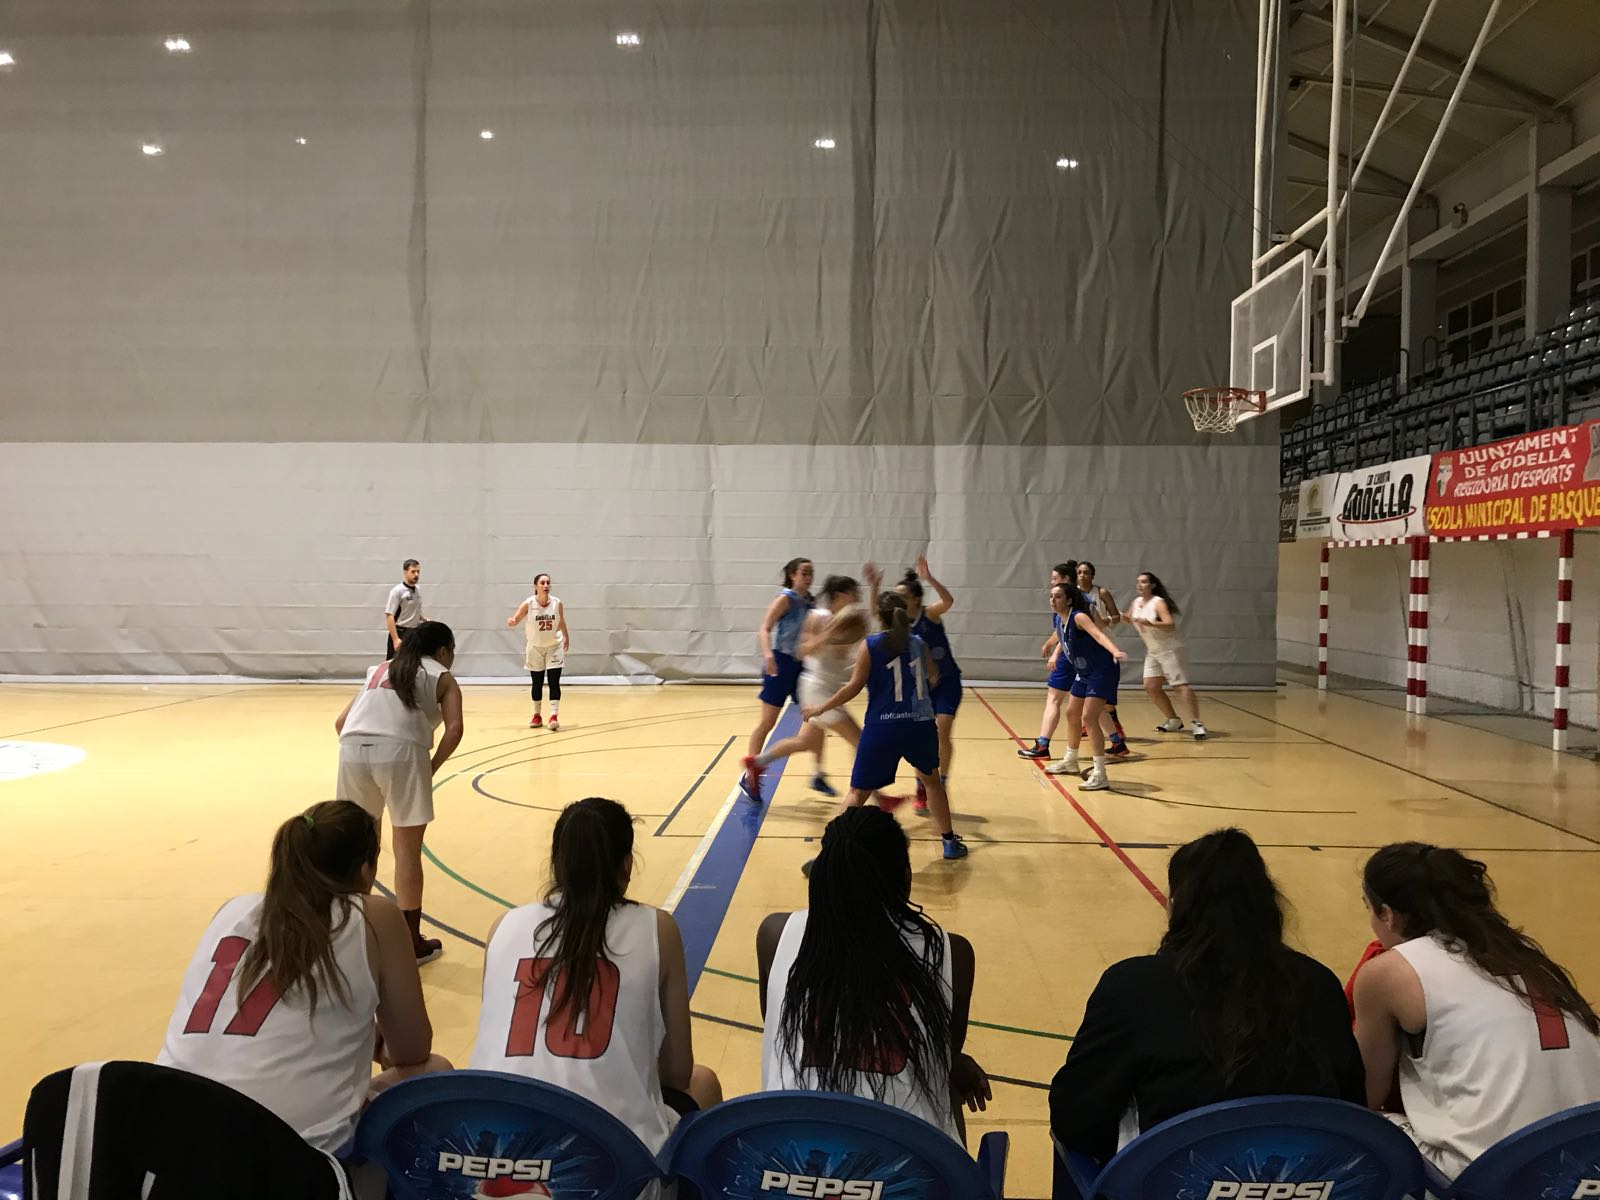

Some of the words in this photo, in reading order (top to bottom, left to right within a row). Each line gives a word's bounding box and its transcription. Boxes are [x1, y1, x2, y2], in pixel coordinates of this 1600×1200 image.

[1458, 427, 1579, 465] AJUNTAMENT
[1464, 464, 1486, 478] DE
[1490, 446, 1572, 473] GODELLA
[1511, 463, 1575, 490] D'ESPORTS
[1342, 473, 1413, 521] GODELLA
[1465, 497, 1526, 528] MUNICIPAL
[1529, 494, 1547, 523] DE
[538, 620, 553, 632] 25
[886, 656, 924, 702] 11
[505, 957, 620, 1060] 10
[438, 1151, 552, 1181] PEPSI
[760, 1169, 884, 1200] PEPSI
[1205, 1180, 1335, 1200] PEPSI
